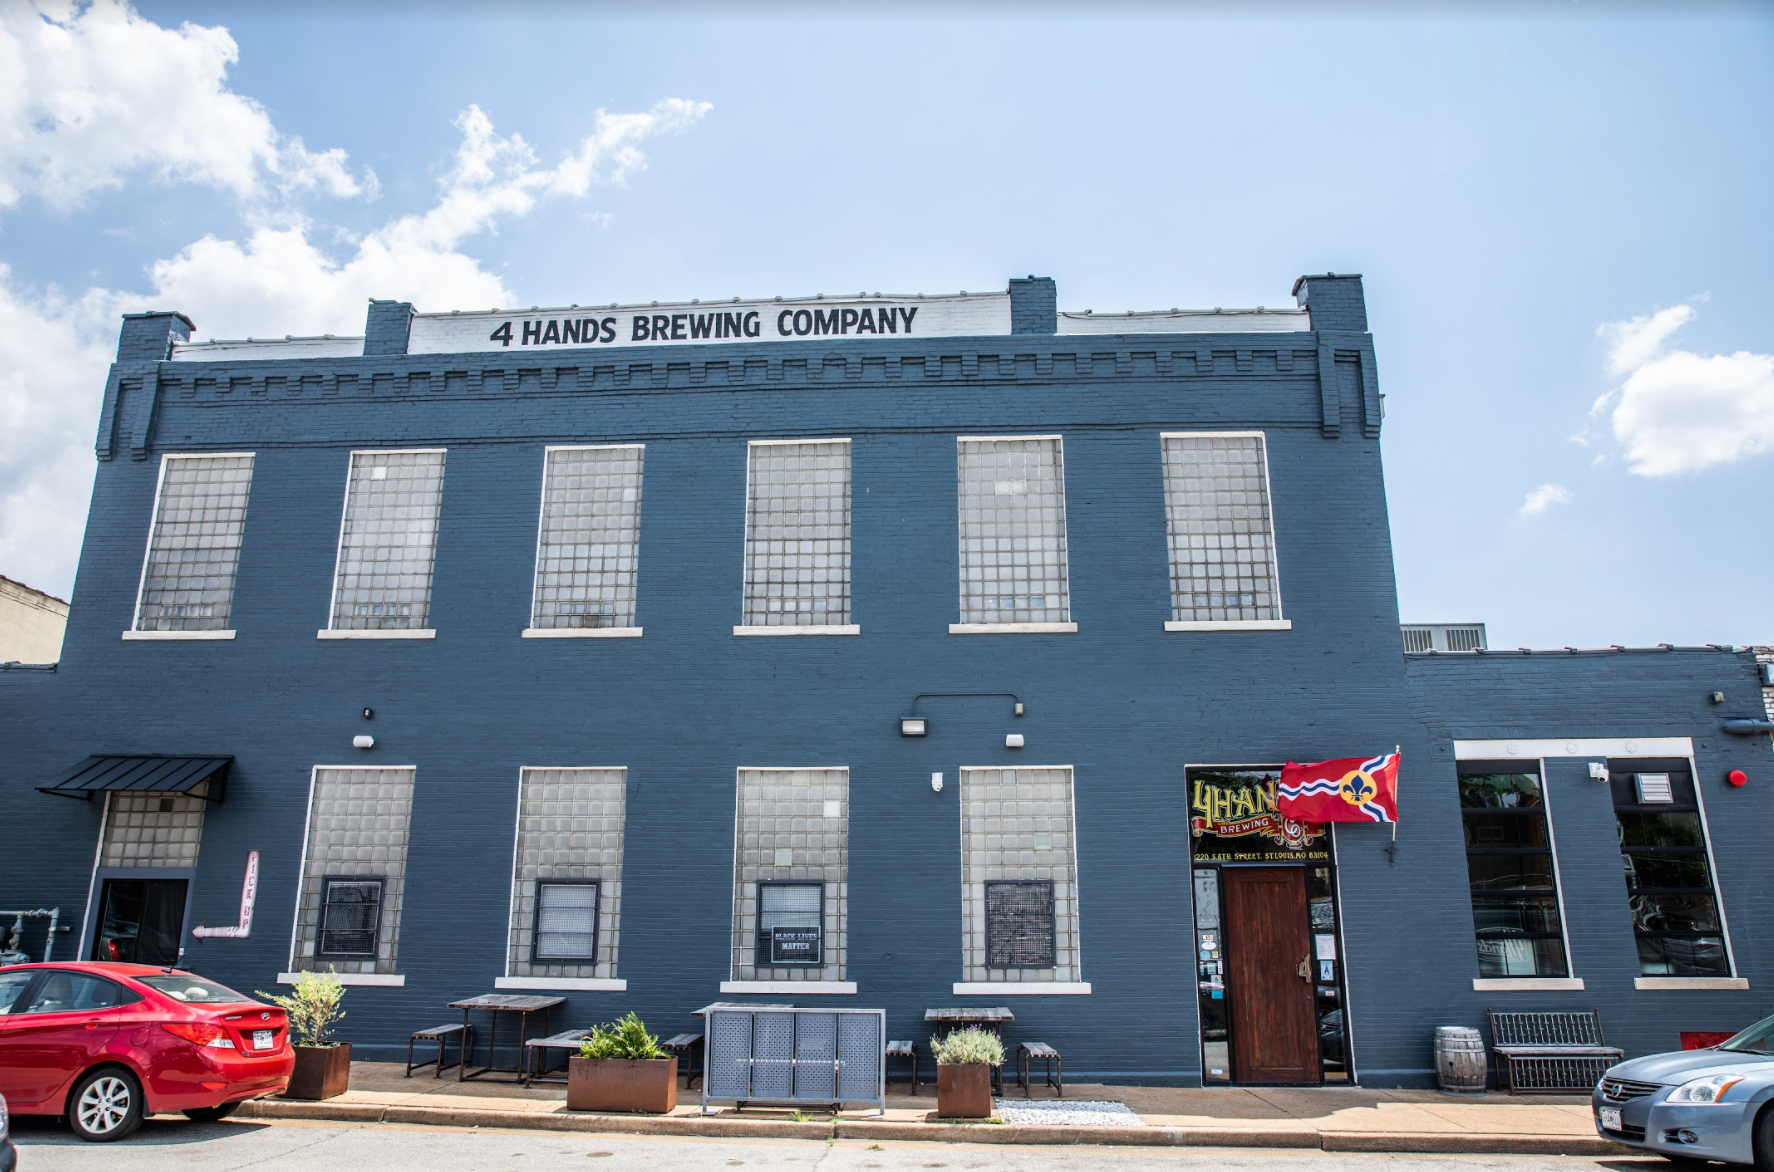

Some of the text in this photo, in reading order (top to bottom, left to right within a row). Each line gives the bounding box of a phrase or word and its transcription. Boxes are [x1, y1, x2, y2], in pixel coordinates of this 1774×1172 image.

[490, 307, 918, 347] 4 HANDS BREWING COMPANY
[1192, 780, 1281, 828] 4HAN
[1220, 817, 1269, 834] BREWING
[1309, 851, 1329, 859] 63104
